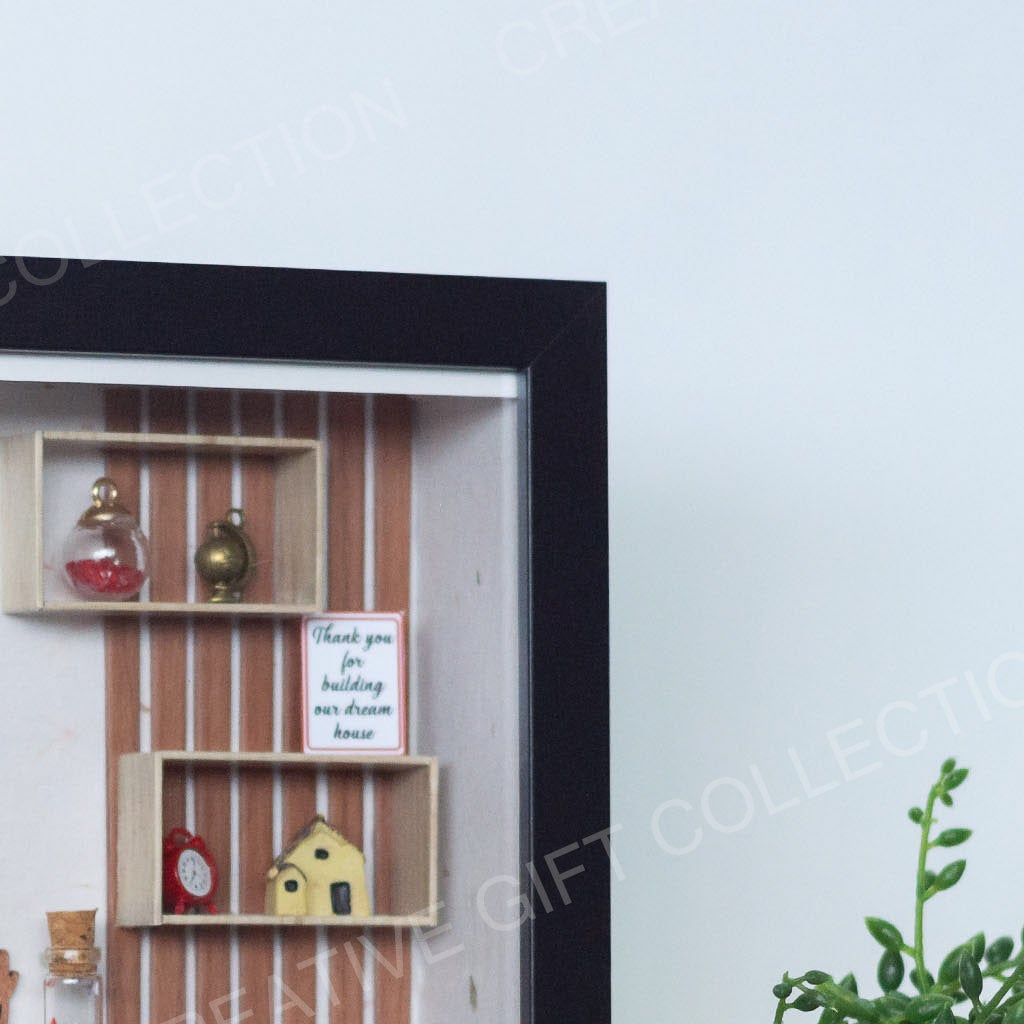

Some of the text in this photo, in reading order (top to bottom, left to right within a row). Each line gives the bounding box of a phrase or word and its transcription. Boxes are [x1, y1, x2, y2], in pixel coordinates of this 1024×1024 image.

[312, 623, 392, 651] Thank you
[341, 650, 364, 675] for
[321, 673, 384, 700] building
[314, 698, 392, 716] our dream
[333, 722, 374, 740] house
